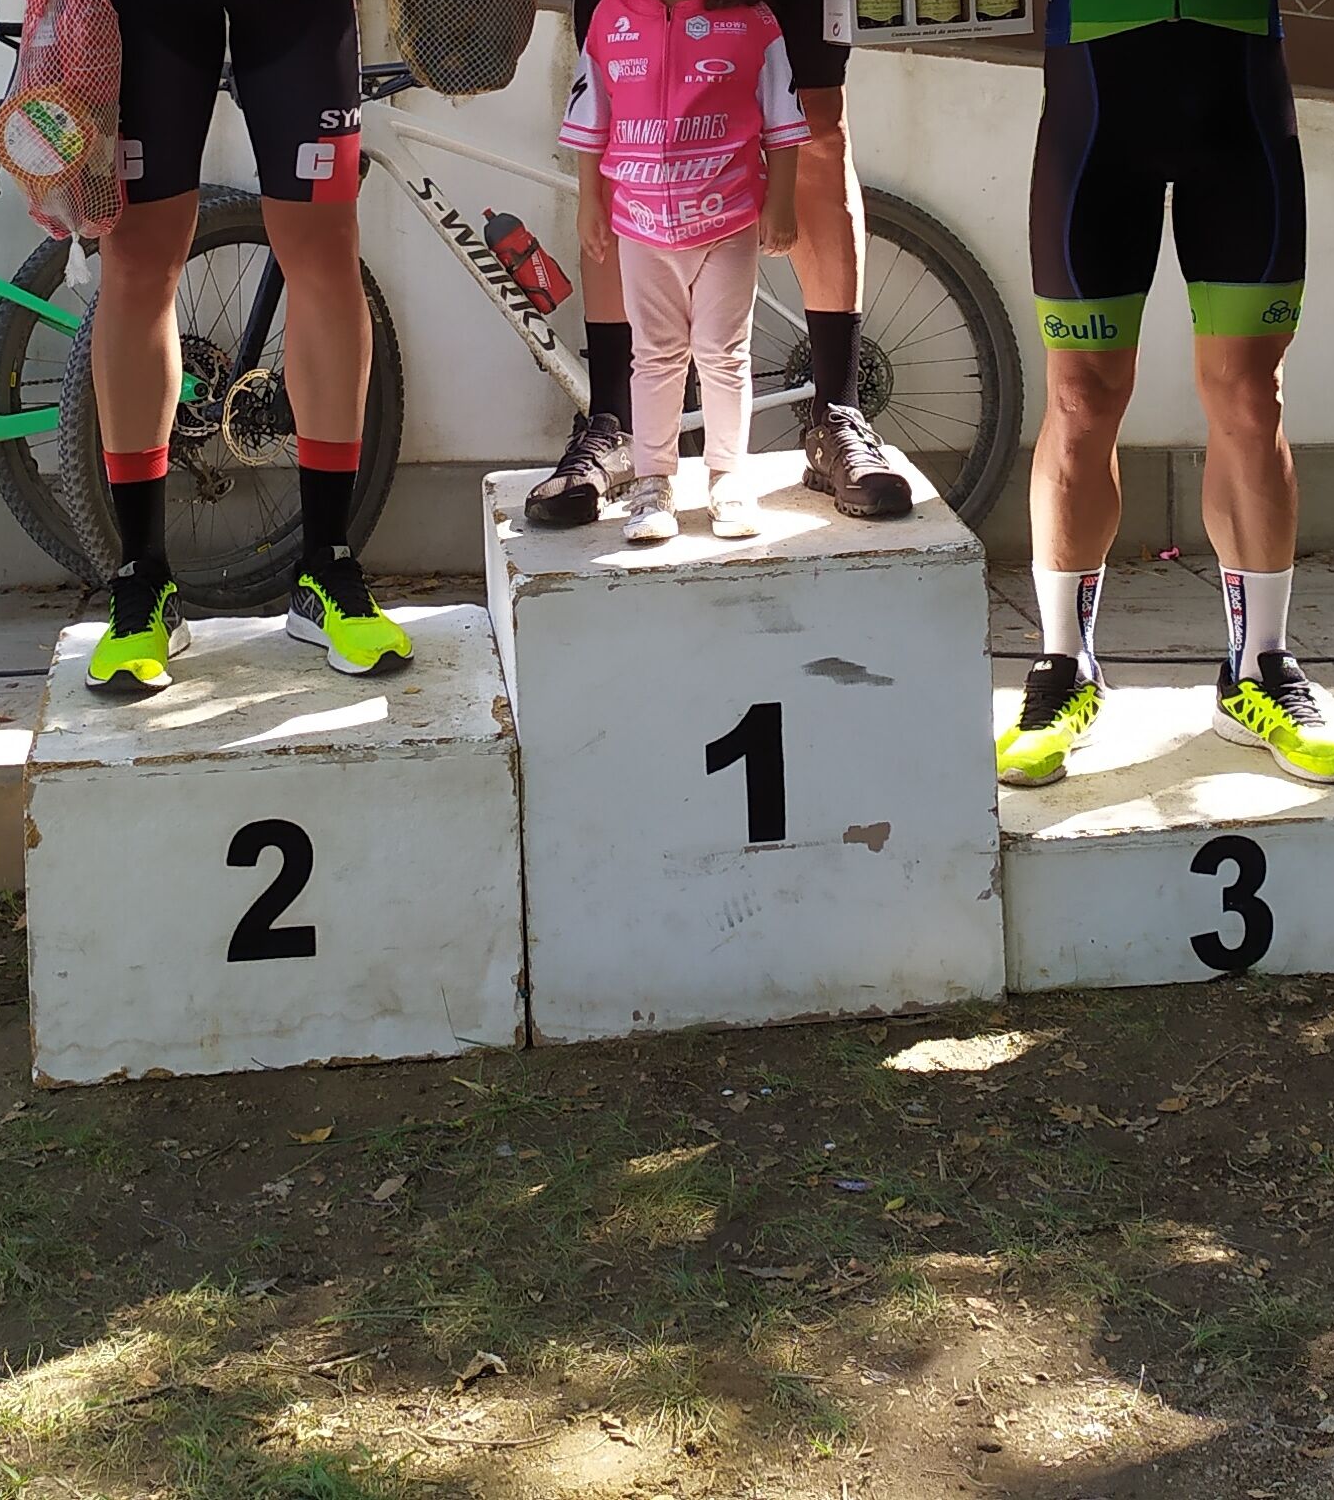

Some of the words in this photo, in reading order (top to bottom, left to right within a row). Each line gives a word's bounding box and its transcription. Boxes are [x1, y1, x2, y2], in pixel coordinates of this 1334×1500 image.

[606, 32, 640, 44] VIATOR
[672, 112, 729, 143] TORRES
[661, 192, 724, 228] LEO
[665, 215, 727, 244] GRUPO
[406, 177, 556, 351] S-WORKS
[1071, 314, 1118, 340] ulb
[705, 702, 786, 844] 1
[226, 818, 317, 963] 2
[1189, 834, 1275, 972] 3
